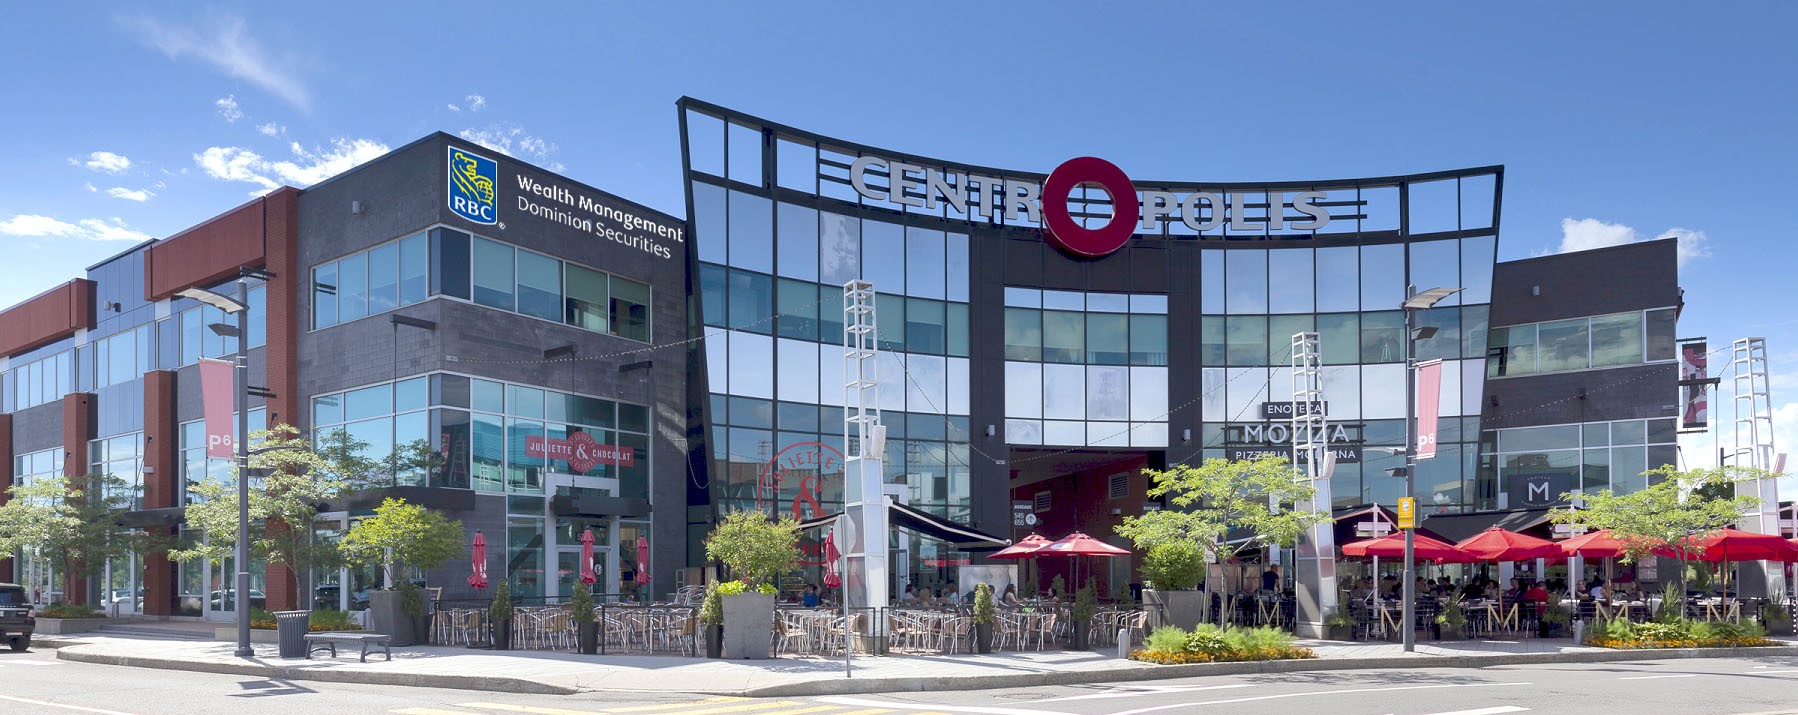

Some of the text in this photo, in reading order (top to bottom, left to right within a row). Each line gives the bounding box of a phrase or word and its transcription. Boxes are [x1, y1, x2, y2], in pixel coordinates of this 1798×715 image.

[454, 195, 492, 221] RBC
[517, 174, 684, 242] Wealth Management
[518, 196, 671, 259] Dominion Securities
[1245, 424, 1349, 443] MOZZA
[530, 442, 630, 461] JULIETTE & CHOCOLAT
[1528, 481, 1549, 501] M
